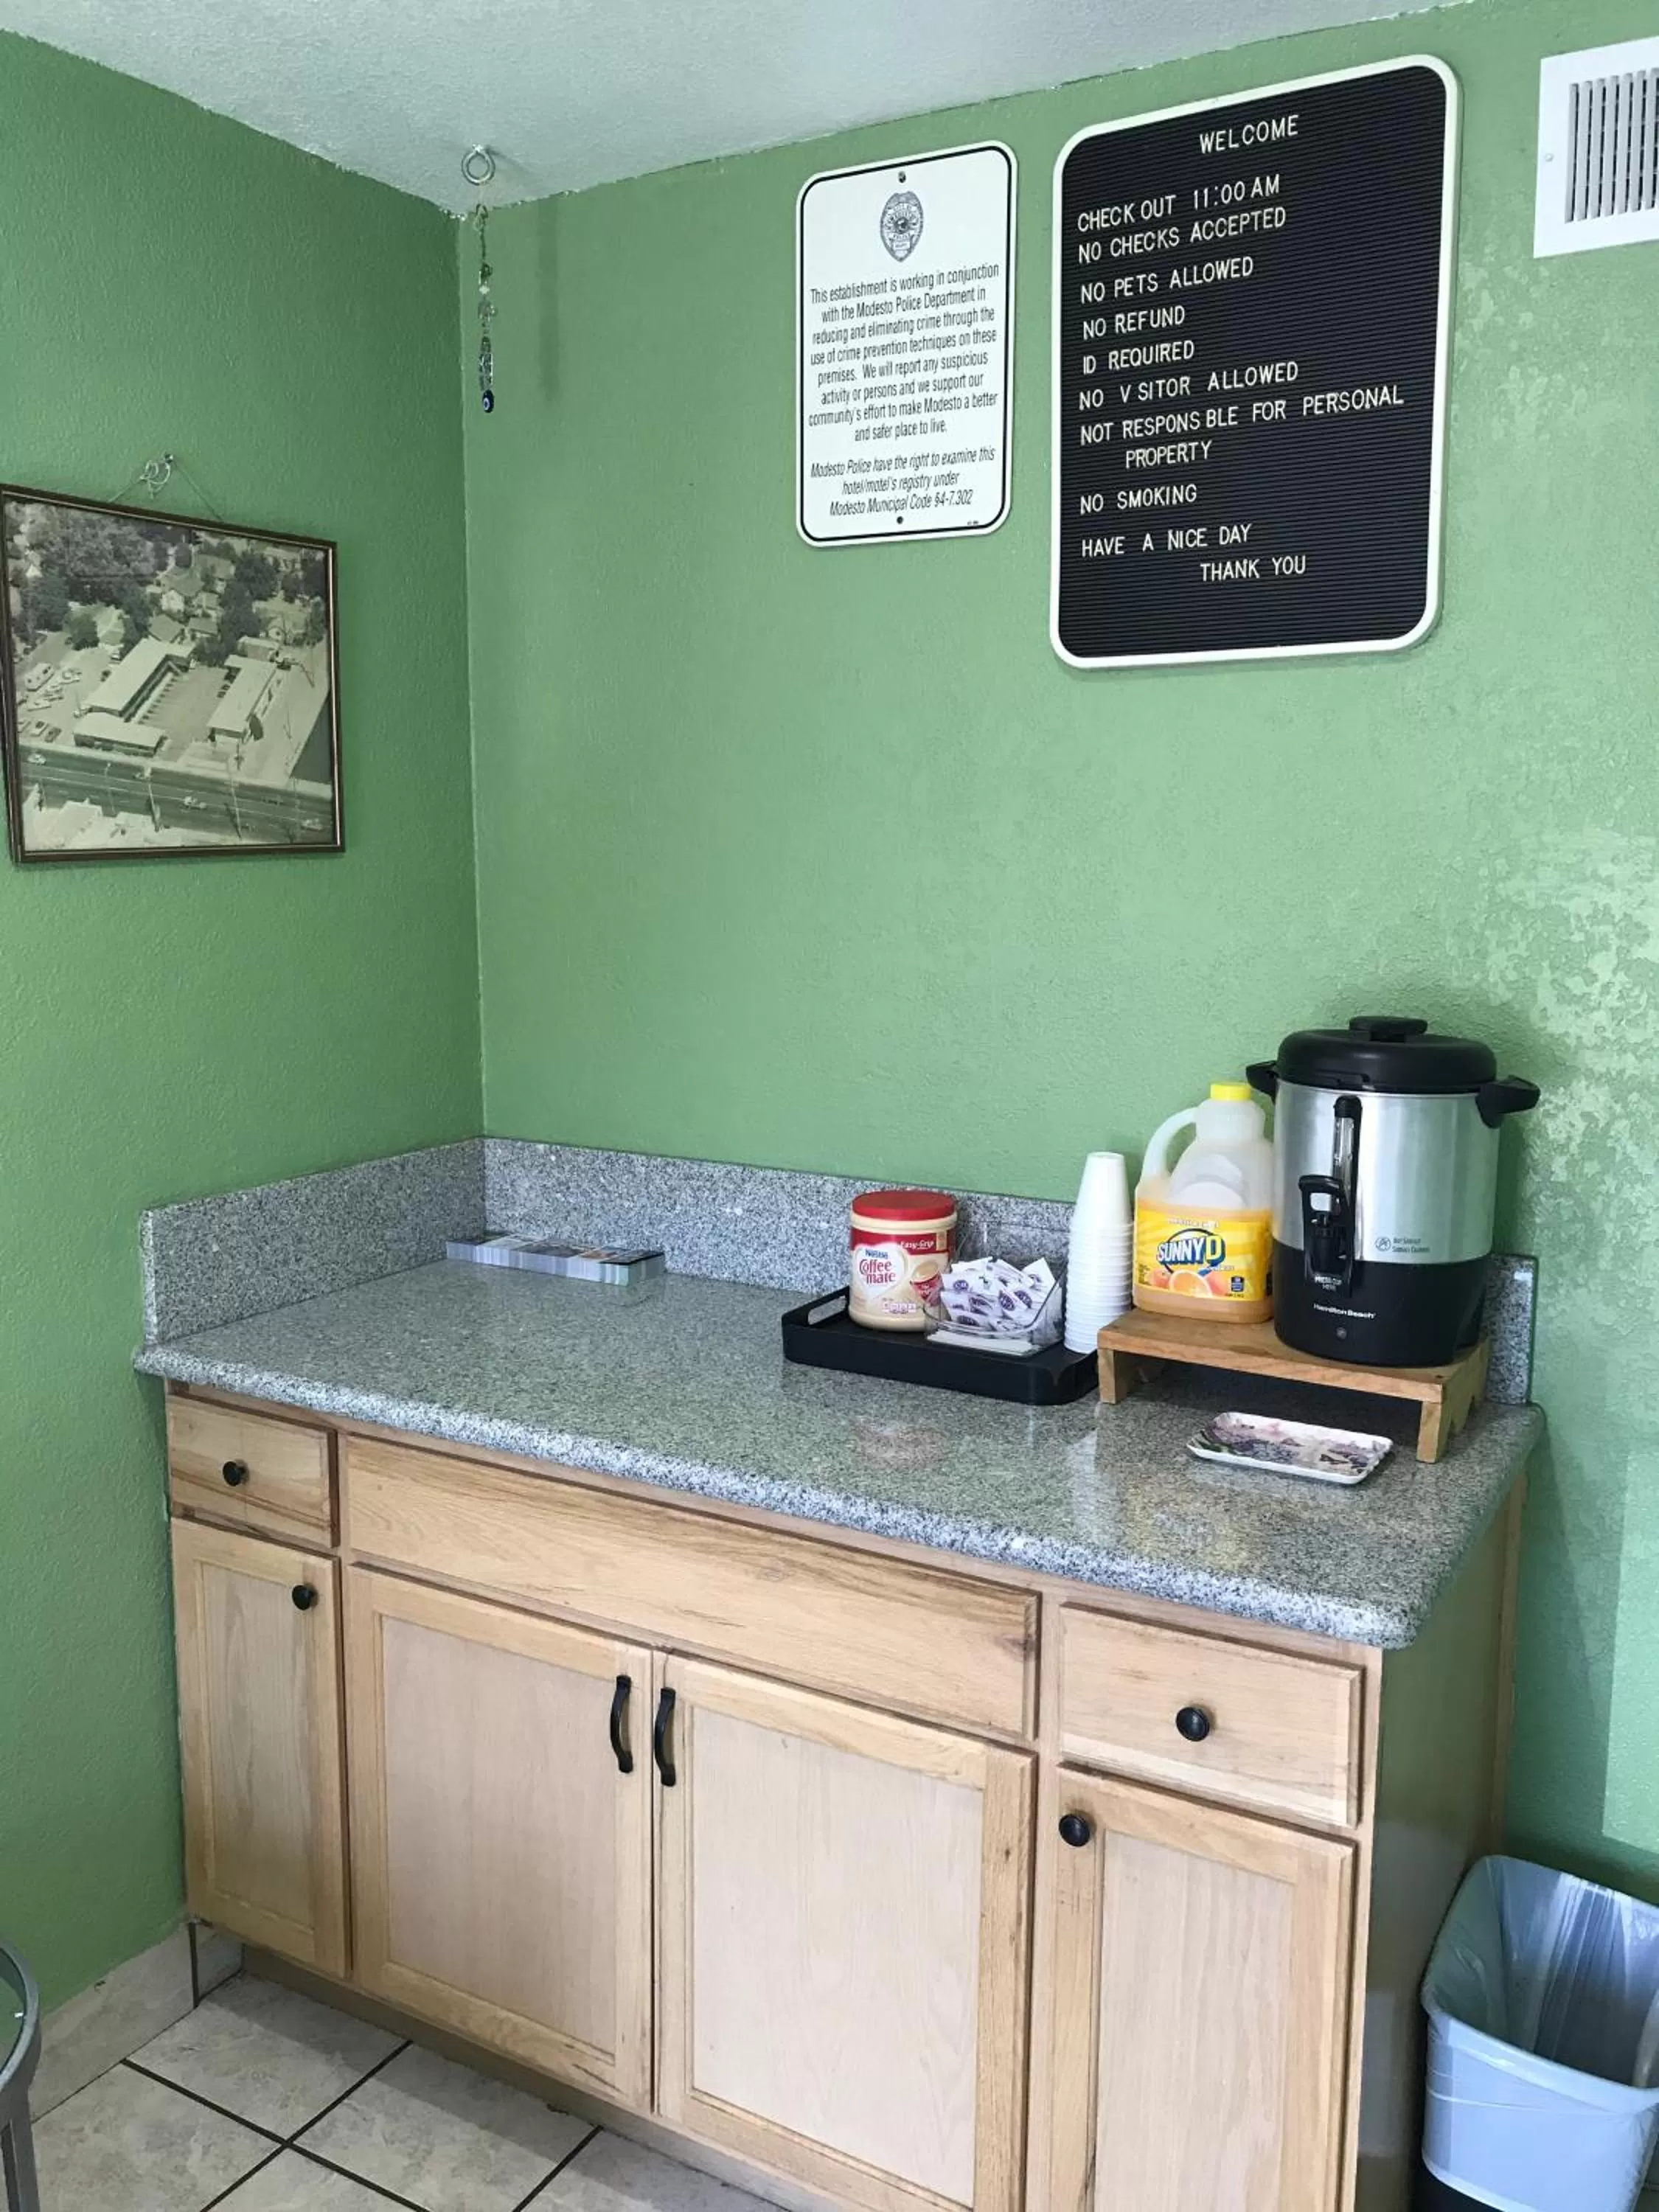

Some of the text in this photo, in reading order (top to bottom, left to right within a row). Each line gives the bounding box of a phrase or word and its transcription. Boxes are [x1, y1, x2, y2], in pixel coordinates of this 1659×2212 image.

[1200, 114, 1298, 154] WELCOME
[1077, 174, 1280, 232] CHECK OUT 11:00 AM
[1079, 206, 1287, 264] NO CHECKS ACCEPTED
[810, 262, 999, 304] This establishment is working in conjunction
[1080, 257, 1253, 304] NO PETS ALLOWED
[821, 285, 986, 322] with the Modesto Police Department in
[813, 307, 994, 344] reducing and eliminating crime through the
[1082, 305, 1185, 340] NO REFUND
[811, 328, 996, 365] use of crime prevention techniques on these
[1082, 340, 1194, 375] ID REQUIRED
[818, 352, 988, 388] premises. We will report any suspicious
[1079, 389, 1104, 411] NO
[1208, 361, 1298, 392] ALLOWED
[821, 373, 984, 405] activity or persons and we support our
[808, 392, 998, 426] community's effort to make Modesto a better
[1080, 422, 1114, 446] NOT
[1253, 400, 1286, 422] FOR
[1303, 384, 1404, 416] PERSONAL
[855, 417, 947, 442] and safer place to live.
[810, 445, 995, 478] Modesto Police have the right to examine this
[1126, 440, 1212, 469] PROPERTY
[899, 473, 933, 493] registry
[933, 470, 960, 487] under
[830, 501, 866, 516] Modesto
[866, 495, 909, 513] Municipal
[910, 493, 933, 510] Code
[1080, 484, 1197, 515] NO SMOKING
[1082, 524, 1252, 557] HAVE A NICE DAY
[1200, 555, 1306, 582] THANK YOU
[859, 1259, 892, 1275] Coffee
